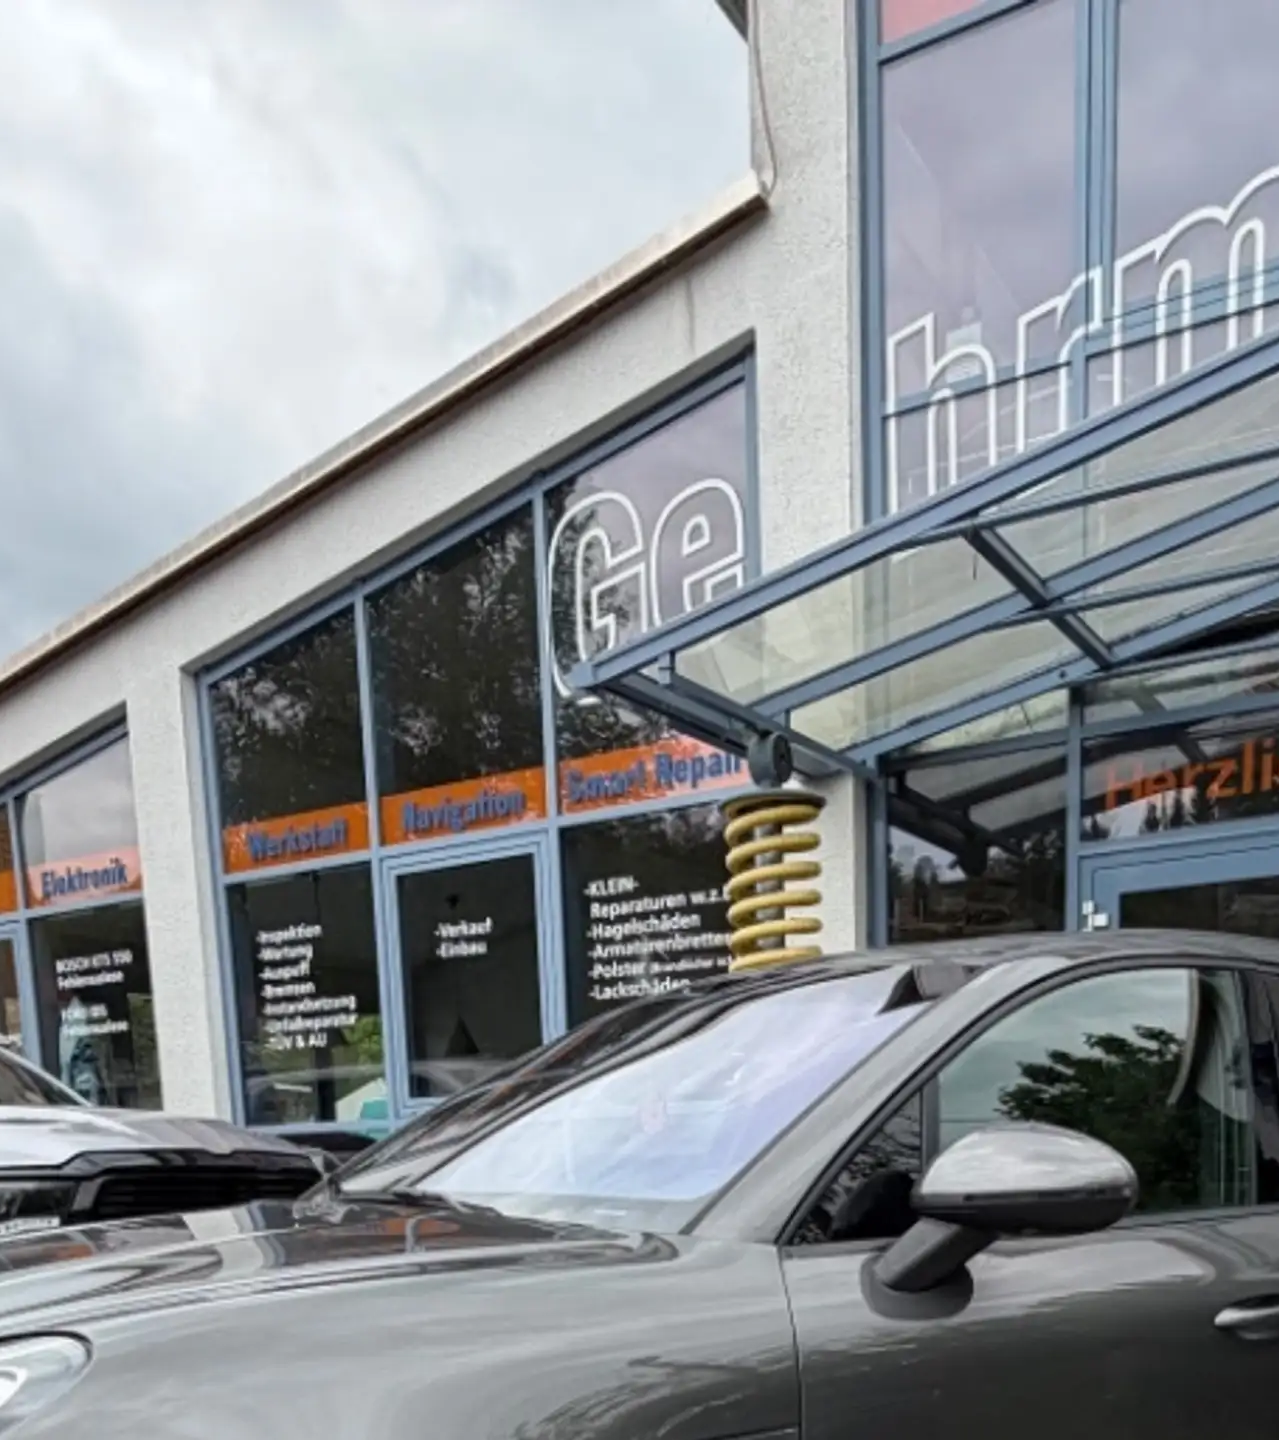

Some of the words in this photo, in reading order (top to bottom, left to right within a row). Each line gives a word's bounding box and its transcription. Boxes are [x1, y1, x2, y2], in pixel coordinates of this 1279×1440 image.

[567, 759, 646, 801] Smart
[403, 789, 527, 833] Navigation
[248, 817, 348, 862] Werkstatt
[40, 857, 128, 898] Elektronik
[589, 893, 687, 920] Reparaturen
